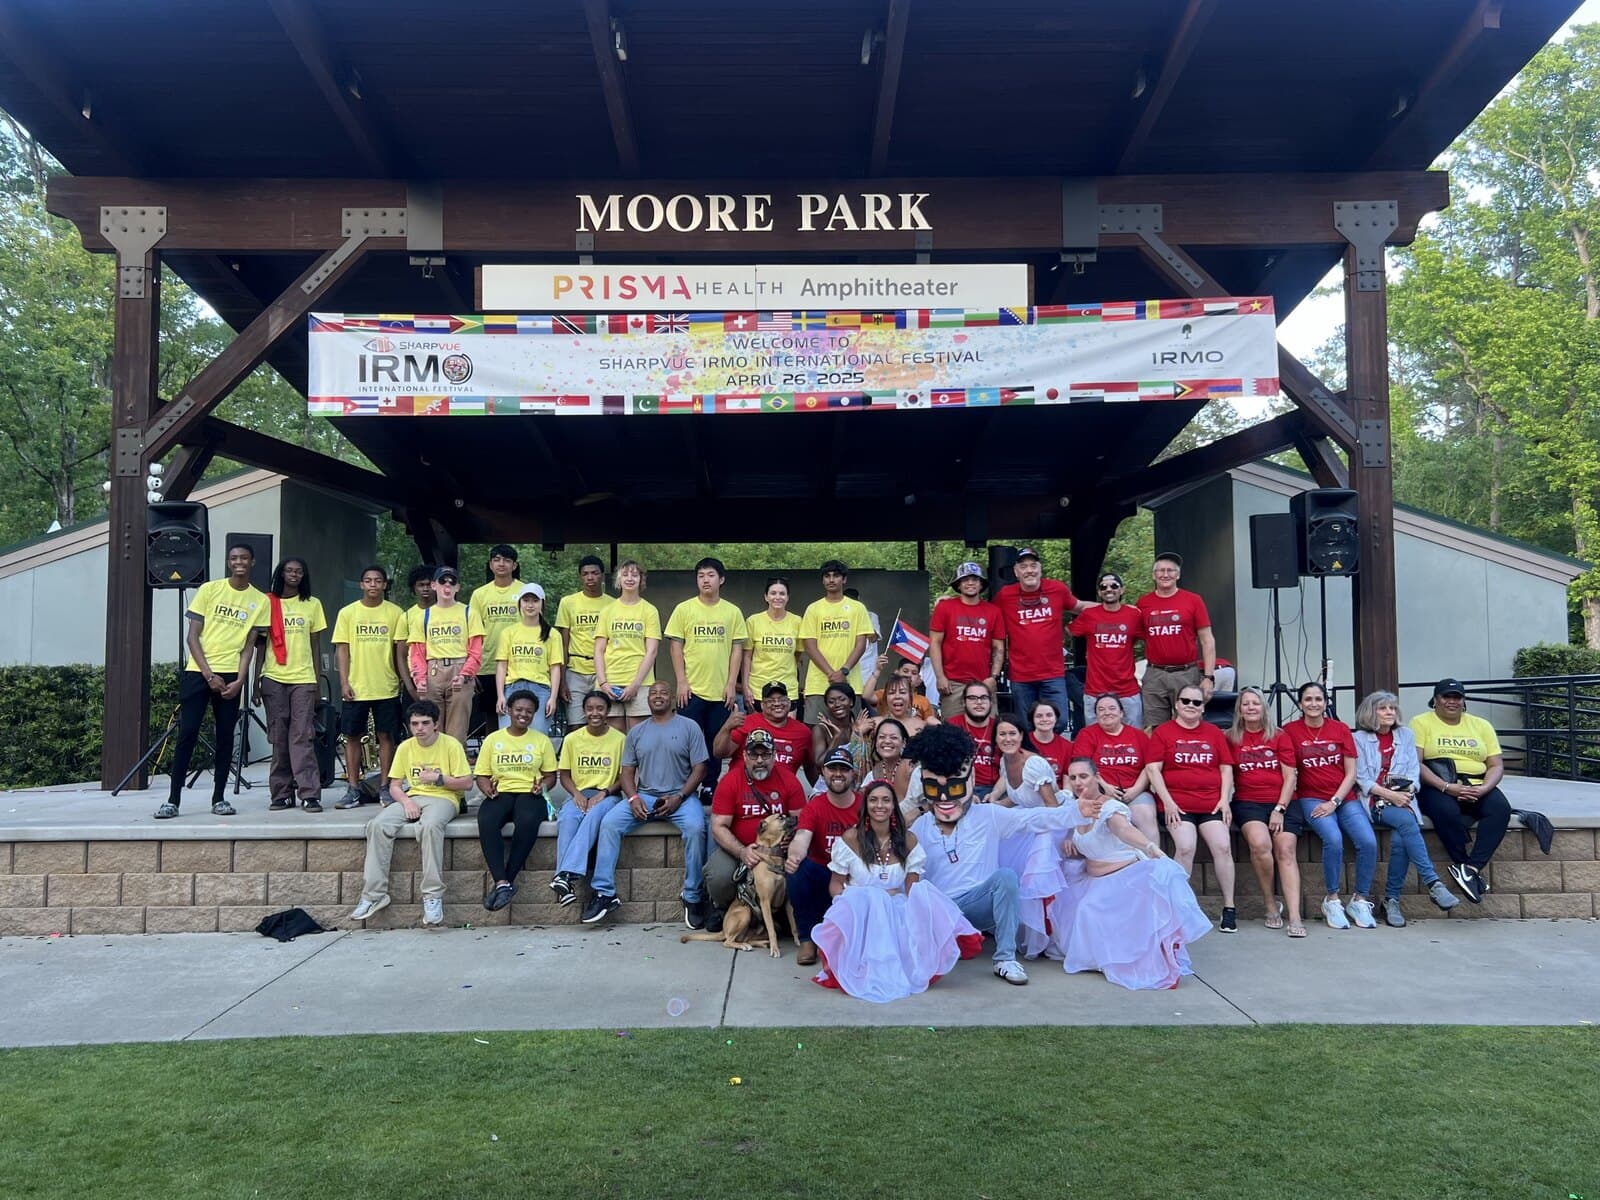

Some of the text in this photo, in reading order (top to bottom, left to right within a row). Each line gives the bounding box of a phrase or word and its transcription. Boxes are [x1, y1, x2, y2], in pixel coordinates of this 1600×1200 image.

[576, 193, 933, 232] MOORE PARK
[553, 275, 959, 301] PRISMA HEALTH Amphitheater
[399, 341, 462, 351] SHARPVUE
[733, 336, 850, 350] WELCOME TO
[600, 350, 985, 370] SHARPVUE IRMO INTERNATIONAL FESTIVAL
[1152, 350, 1224, 365] IRMO
[359, 353, 474, 385] IRMO
[726, 374, 777, 387] APRIL
[817, 371, 865, 385] 2025
[358, 385, 474, 393] INTERNATIONAL FESTIVAL
[487, 606, 518, 615] IRMO
[1017, 606, 1052, 619] TEAM
[576, 615, 599, 624] IRM
[820, 620, 850, 631] IRMO
[355, 625, 389, 634] IRMO
[611, 622, 644, 631] IRMO
[694, 625, 725, 636] IRMO
[956, 625, 987, 638] TEAM
[1148, 624, 1182, 636] STAFF
[761, 636, 793, 646] IRMO
[1094, 633, 1127, 644] TEAM
[511, 645, 543, 657] IRMO
[1437, 737, 1478, 748] IRMO
[577, 756, 612, 767] IRMO
[1100, 756, 1138, 766] STAFF
[1174, 752, 1214, 764] STAFF
[1302, 754, 1341, 768] STAFF
[1239, 760, 1278, 772] STAFF
[742, 803, 783, 815] TEAM
